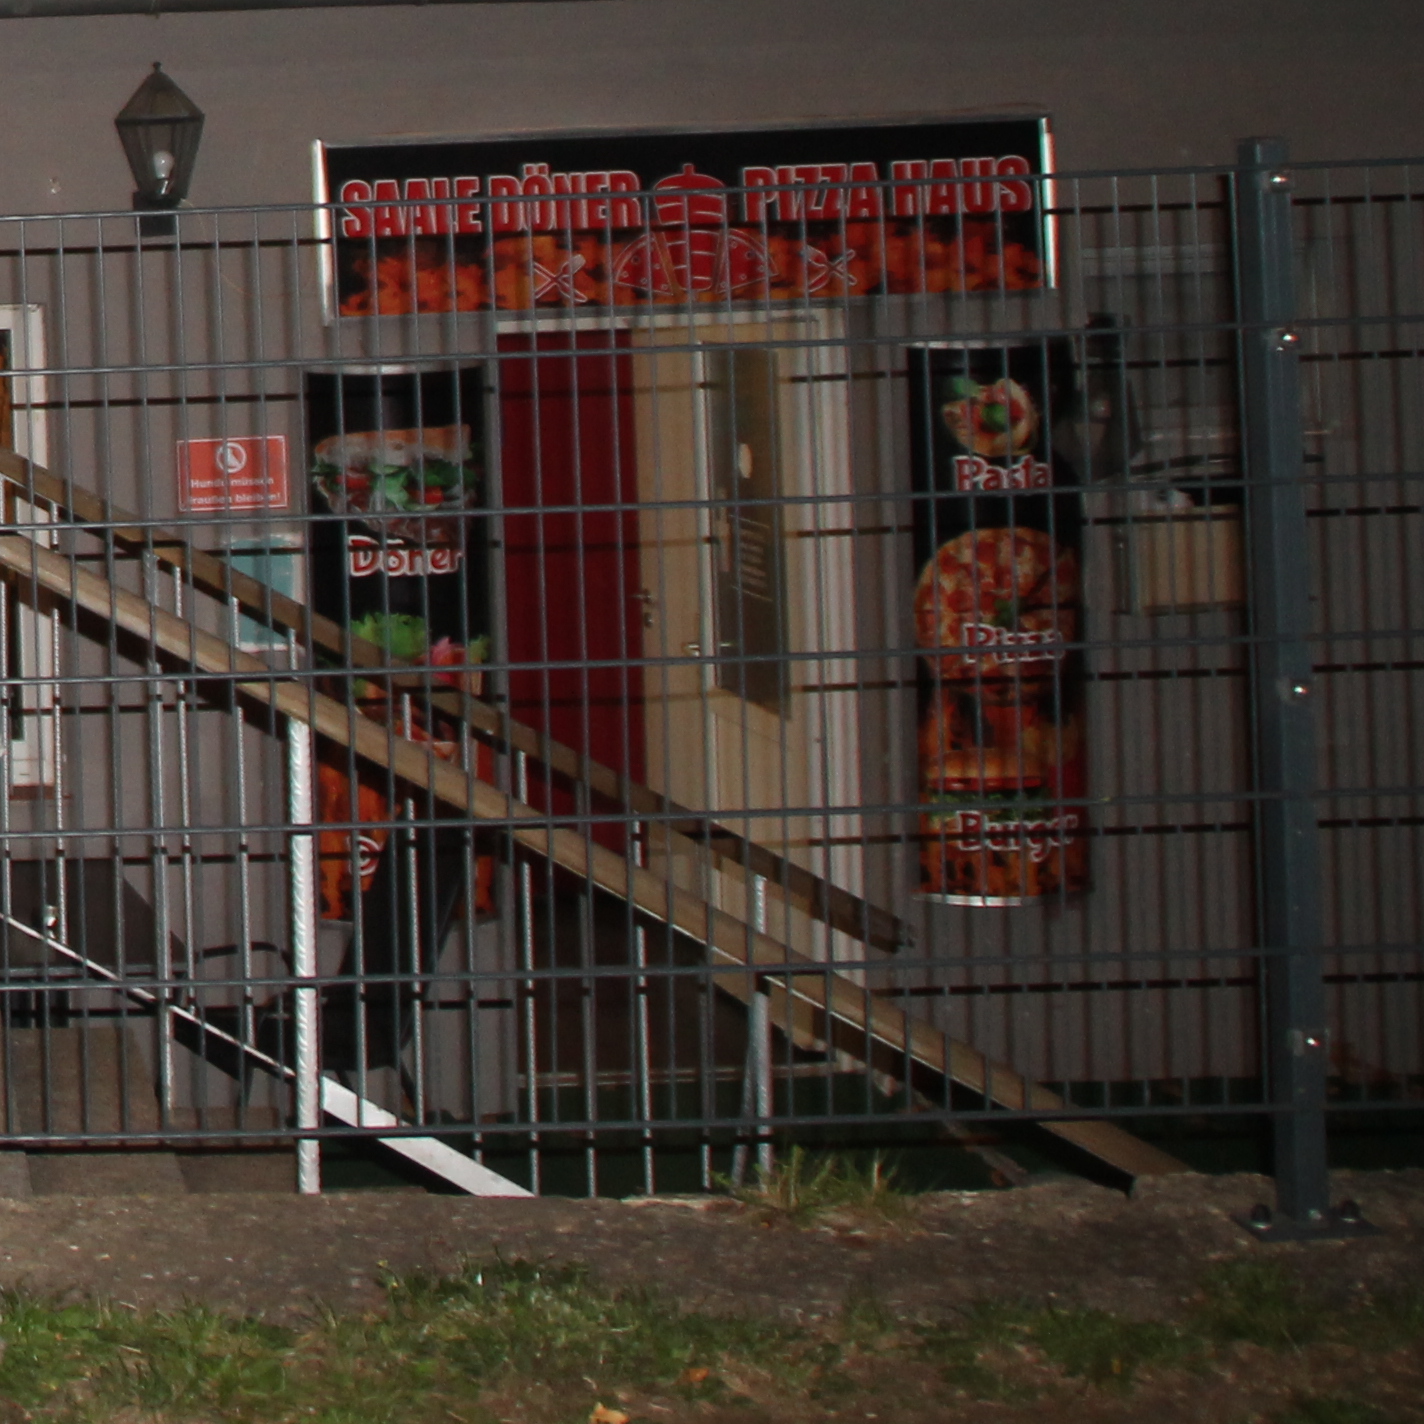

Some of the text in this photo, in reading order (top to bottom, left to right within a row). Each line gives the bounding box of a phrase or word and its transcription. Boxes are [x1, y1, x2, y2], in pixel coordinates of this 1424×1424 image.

[340, 154, 1033, 238] SAALE DÖNER PIZZA HAUS
[951, 453, 1051, 496] Pasta
